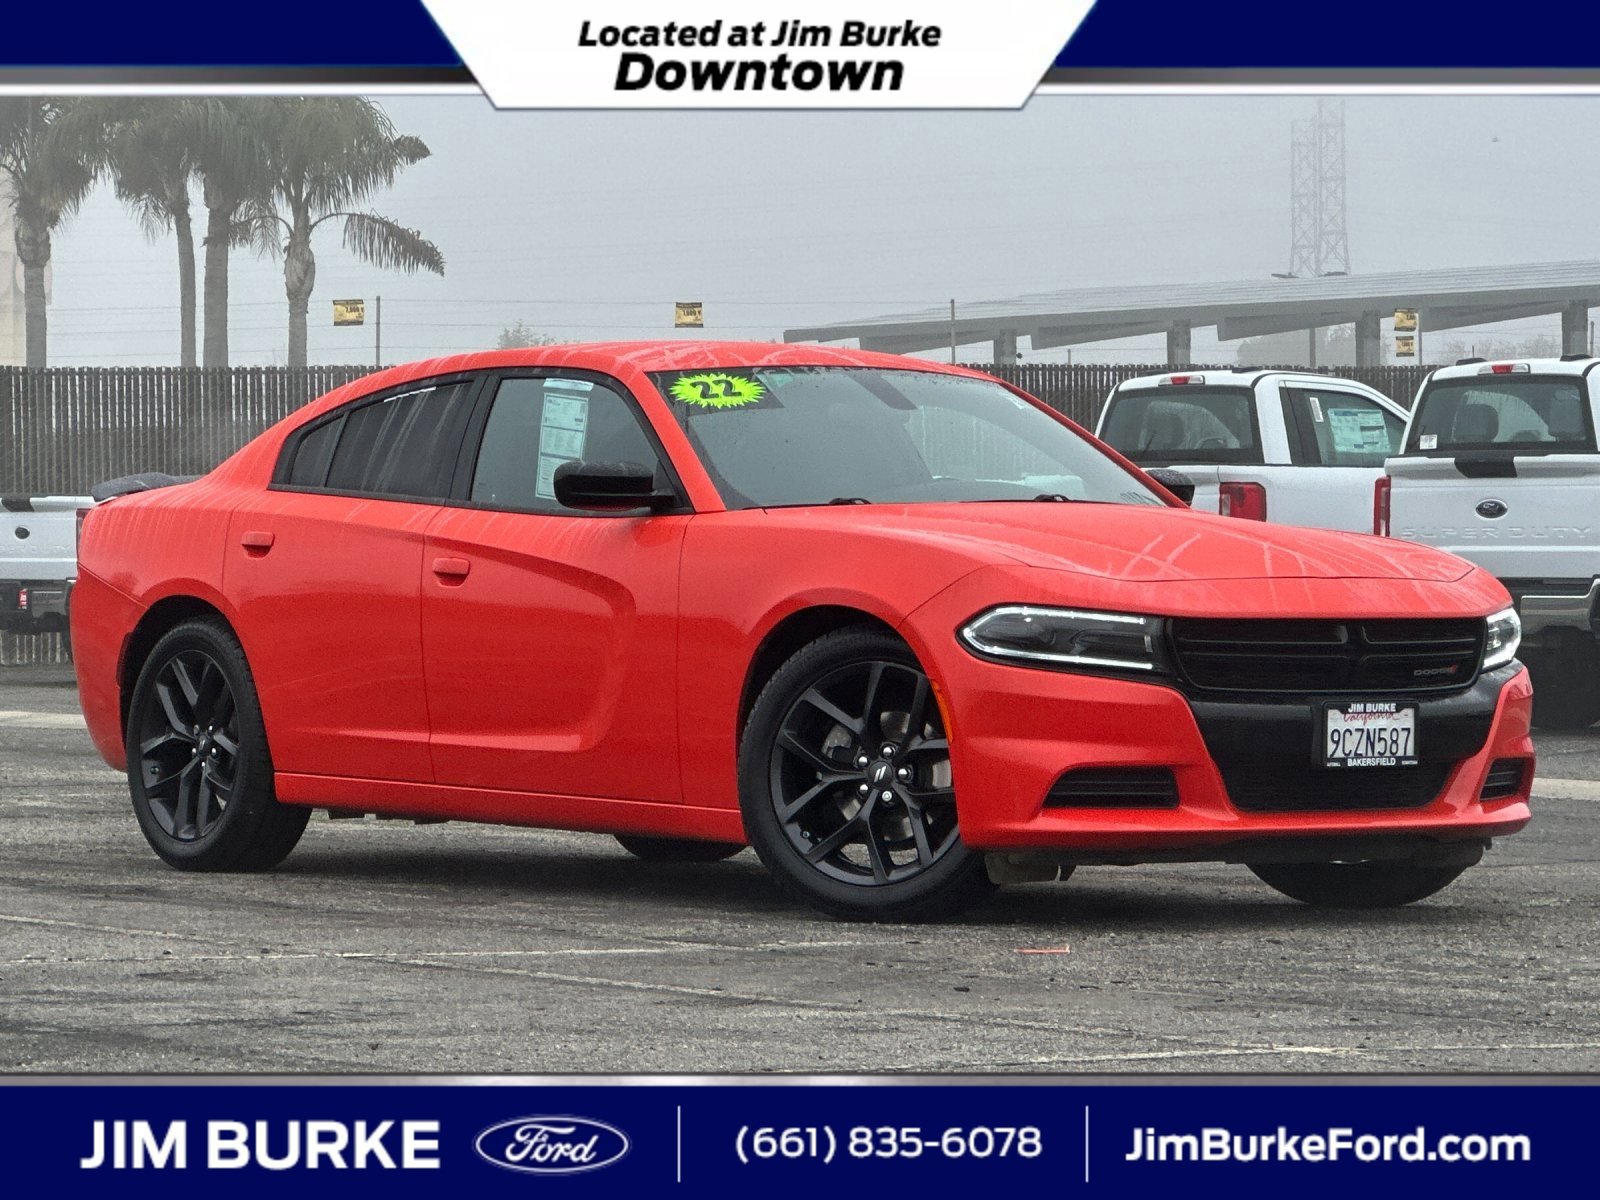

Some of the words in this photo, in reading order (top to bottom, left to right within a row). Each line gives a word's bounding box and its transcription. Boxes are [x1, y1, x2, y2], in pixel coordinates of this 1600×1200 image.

[690, 379, 742, 399] 22
[1401, 526, 1499, 539] SUPER
[1508, 525, 1592, 538] DUTY
[1348, 703, 1364, 713] JIM
[1365, 703, 1397, 713] BURKE
[1329, 727, 1411, 758] 9CZN587
[1347, 757, 1396, 767] BAKERSFIELD
